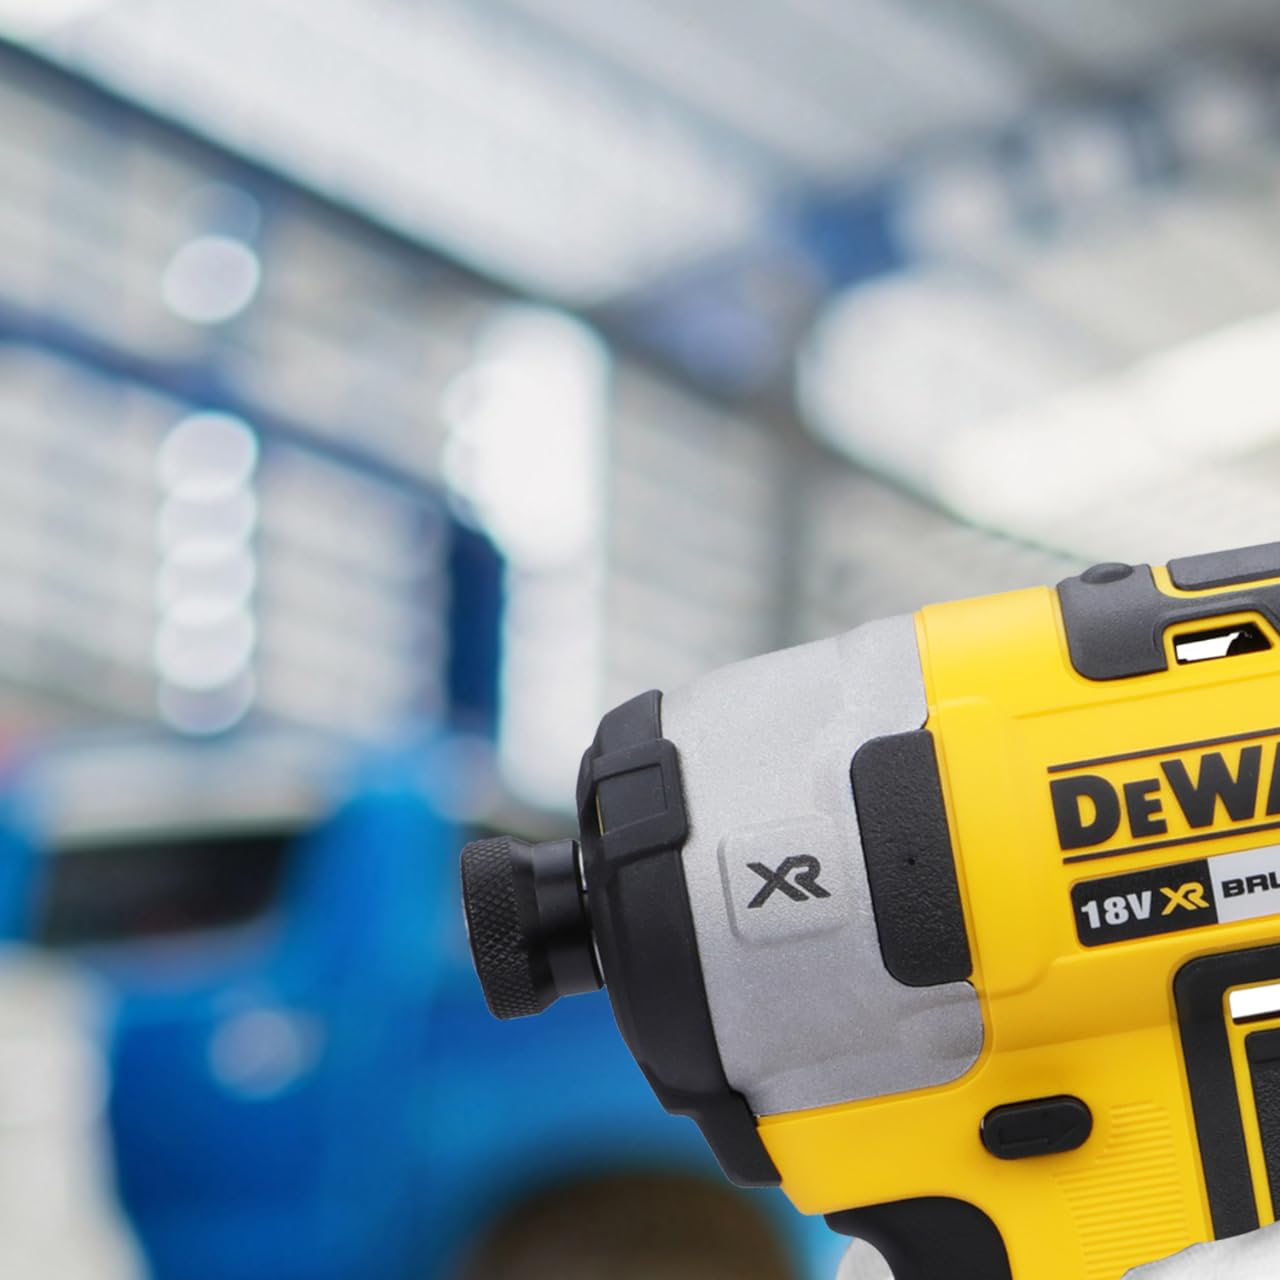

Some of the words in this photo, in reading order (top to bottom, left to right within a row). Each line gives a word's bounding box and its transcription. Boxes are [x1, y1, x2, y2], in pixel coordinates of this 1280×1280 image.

[746, 854, 832, 909] XR
[1080, 890, 1152, 929] 18V
[1160, 881, 1210, 917] XR
